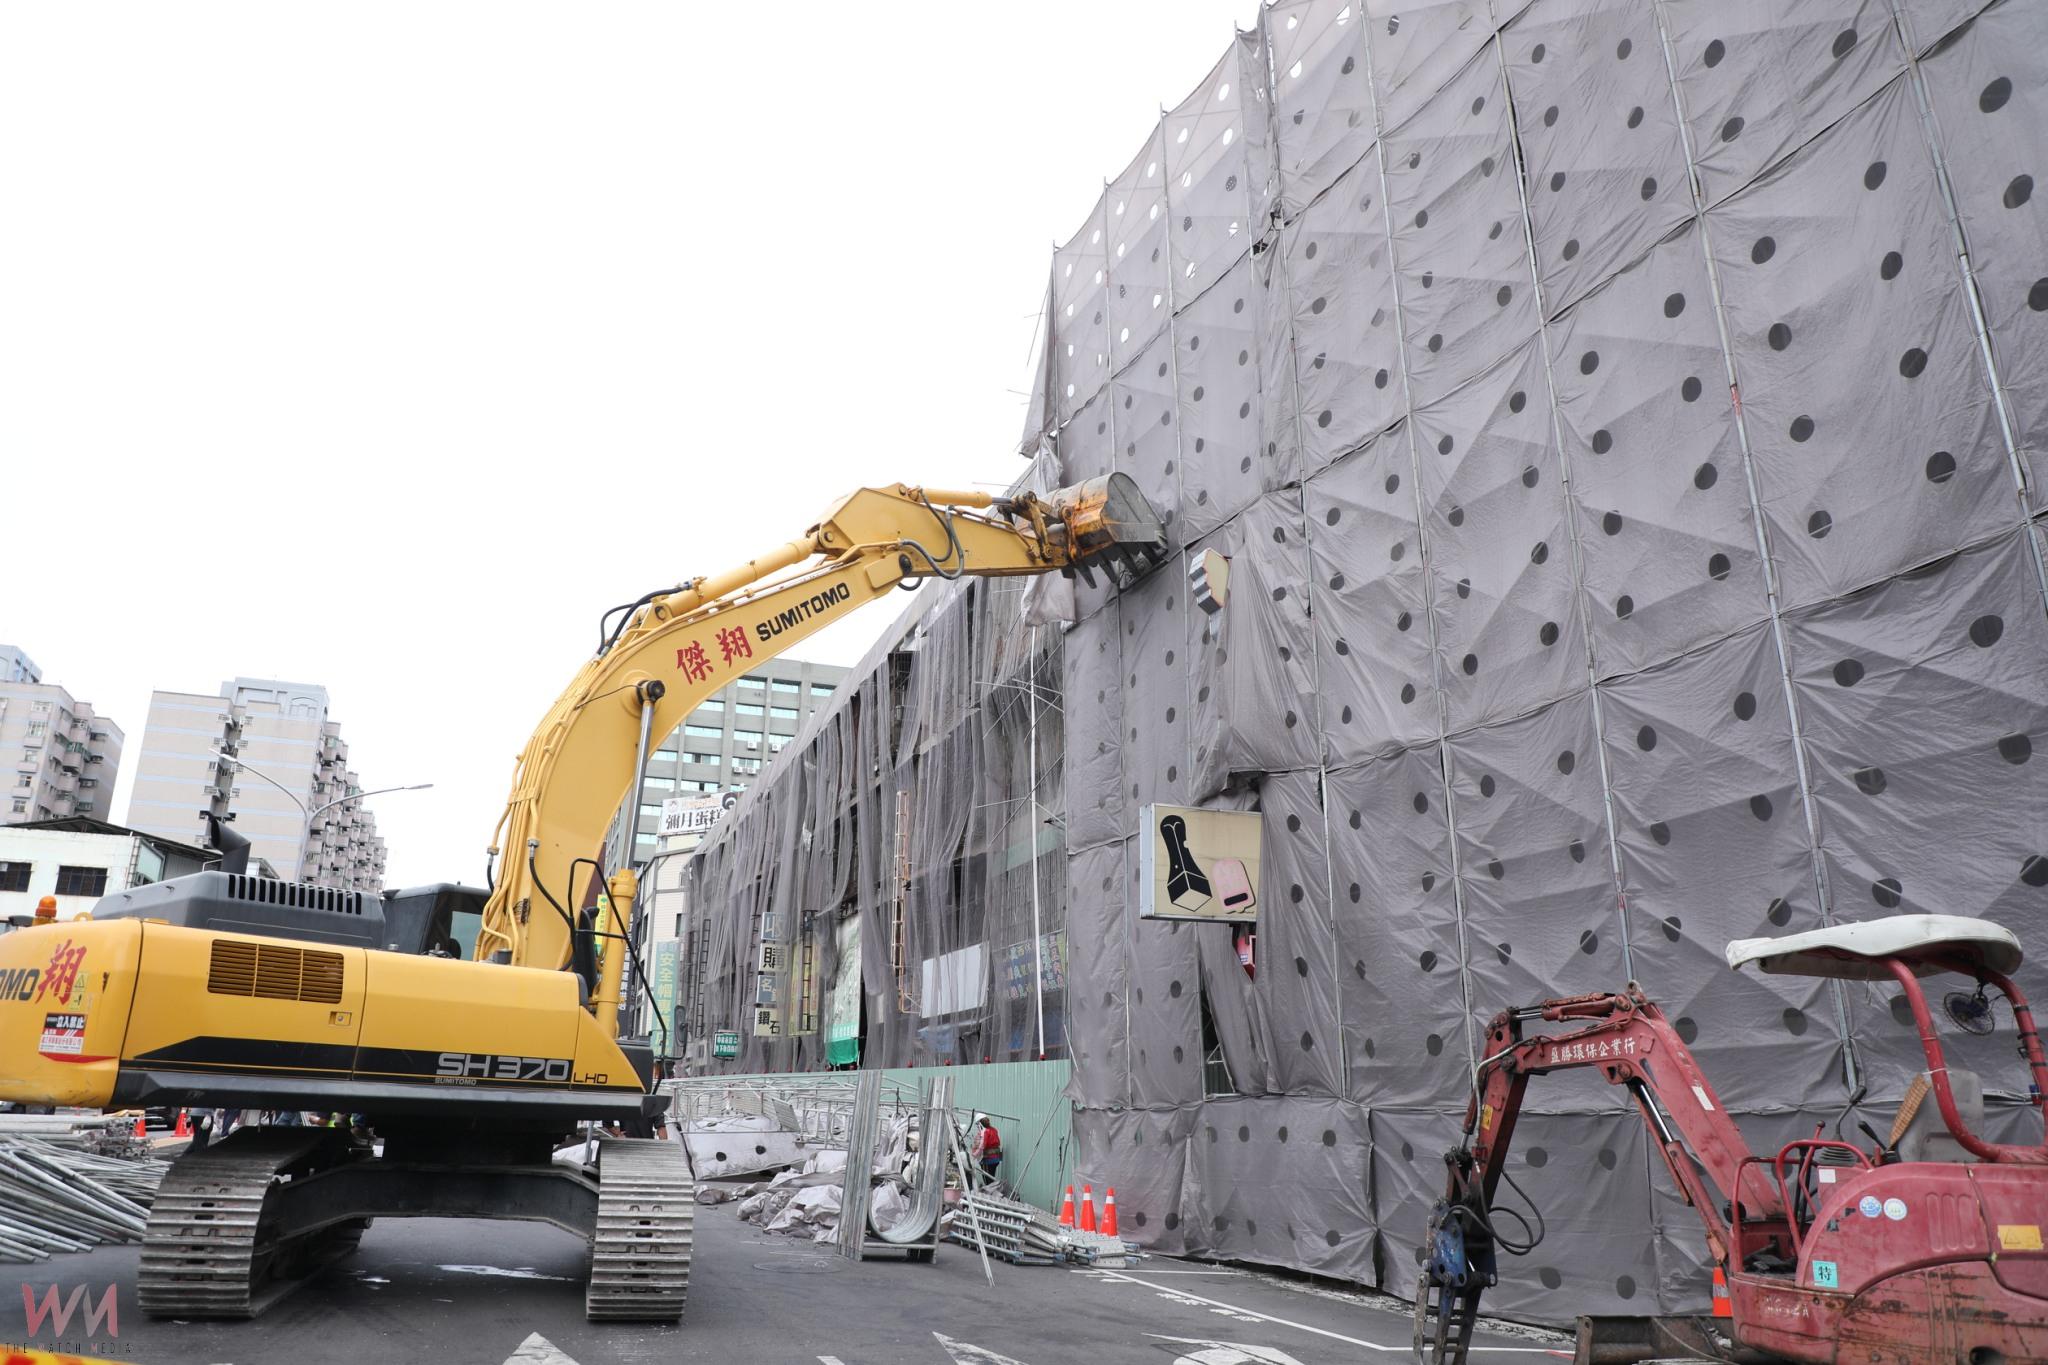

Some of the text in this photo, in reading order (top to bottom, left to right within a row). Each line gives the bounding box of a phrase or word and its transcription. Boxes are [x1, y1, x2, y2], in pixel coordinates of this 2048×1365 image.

[756, 582, 850, 642] SUMITOMO
[676, 625, 753, 685] 傑翔
[0, 968, 40, 1001] MO
[35, 938, 87, 1005] 翔
[435, 1077, 477, 1086] SUMITOMO
[1818, 1266, 1832, 1281] 特
